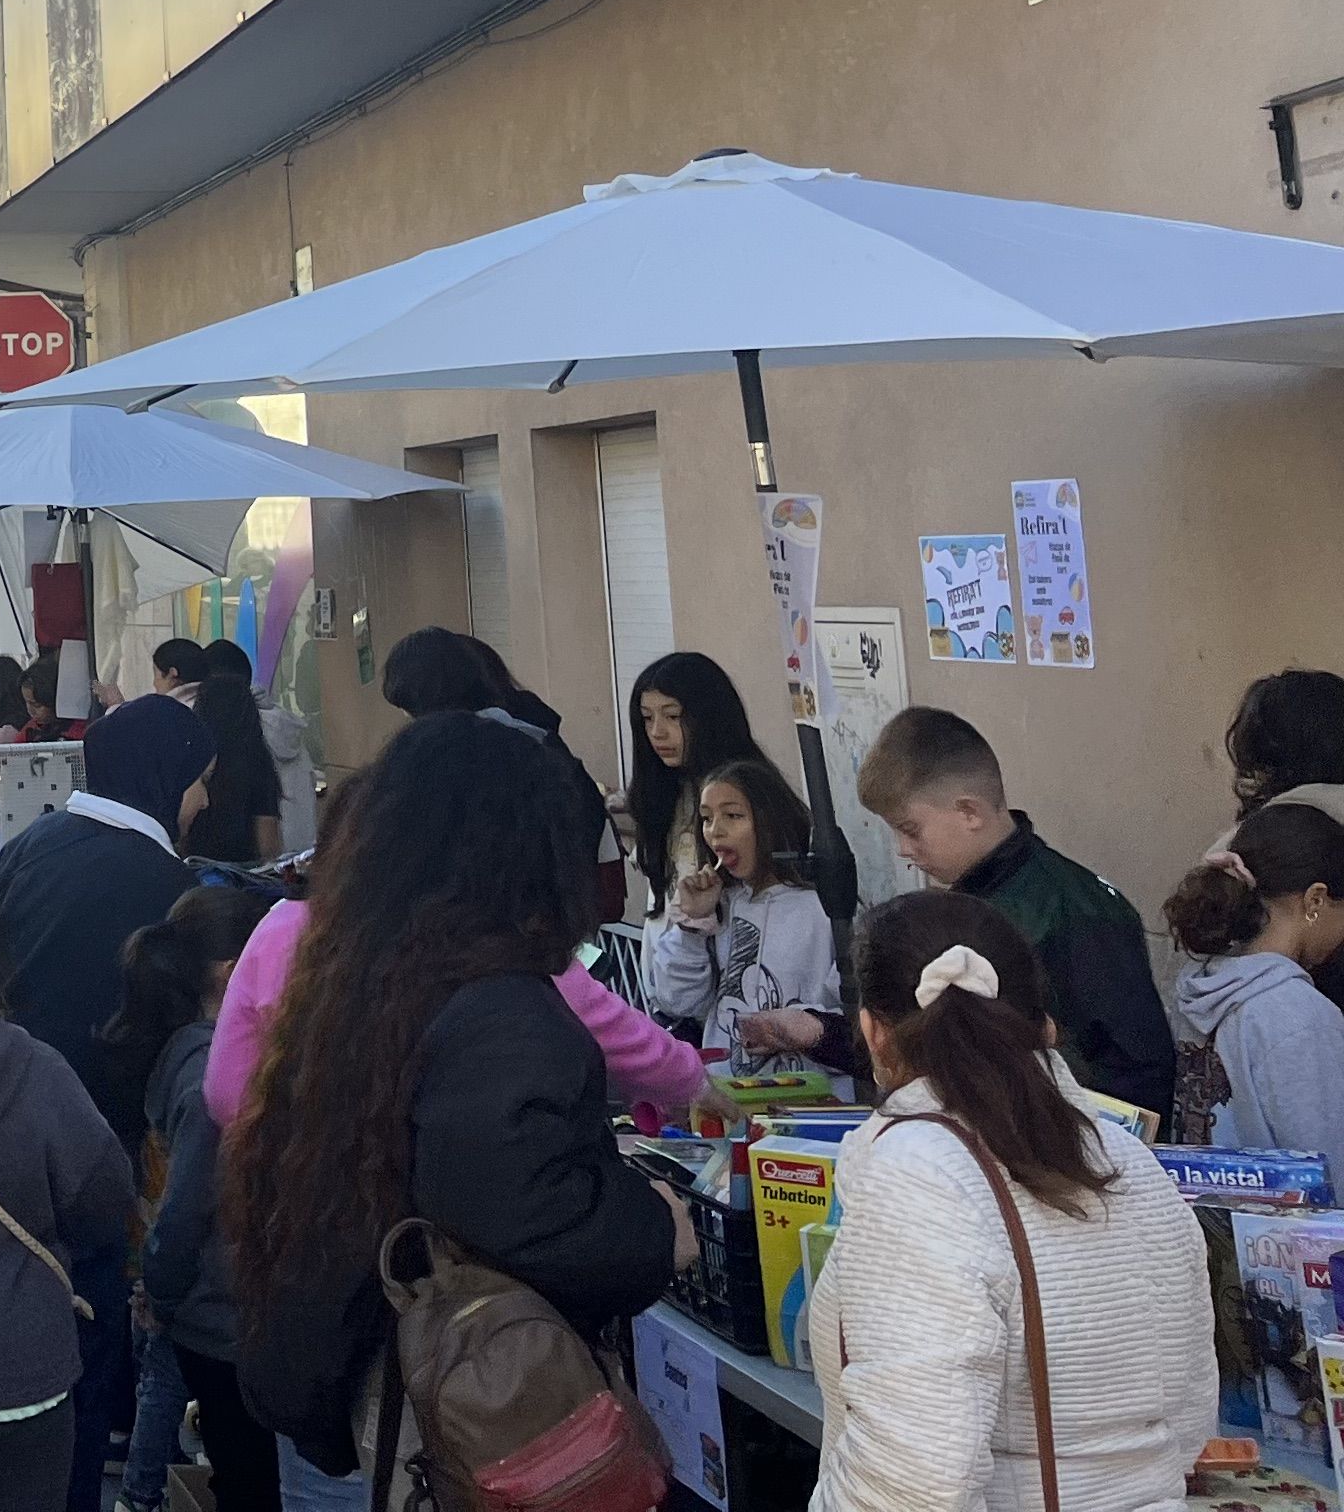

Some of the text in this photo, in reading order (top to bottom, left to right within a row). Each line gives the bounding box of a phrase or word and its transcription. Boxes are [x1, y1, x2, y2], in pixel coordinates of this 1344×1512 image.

[1020, 515, 1068, 536] Refira't
[1185, 1166, 1203, 1184] la
[1207, 1168, 1265, 1187] vista!
[761, 1186, 826, 1207] Tubation
[764, 1210, 790, 1228] 3+
